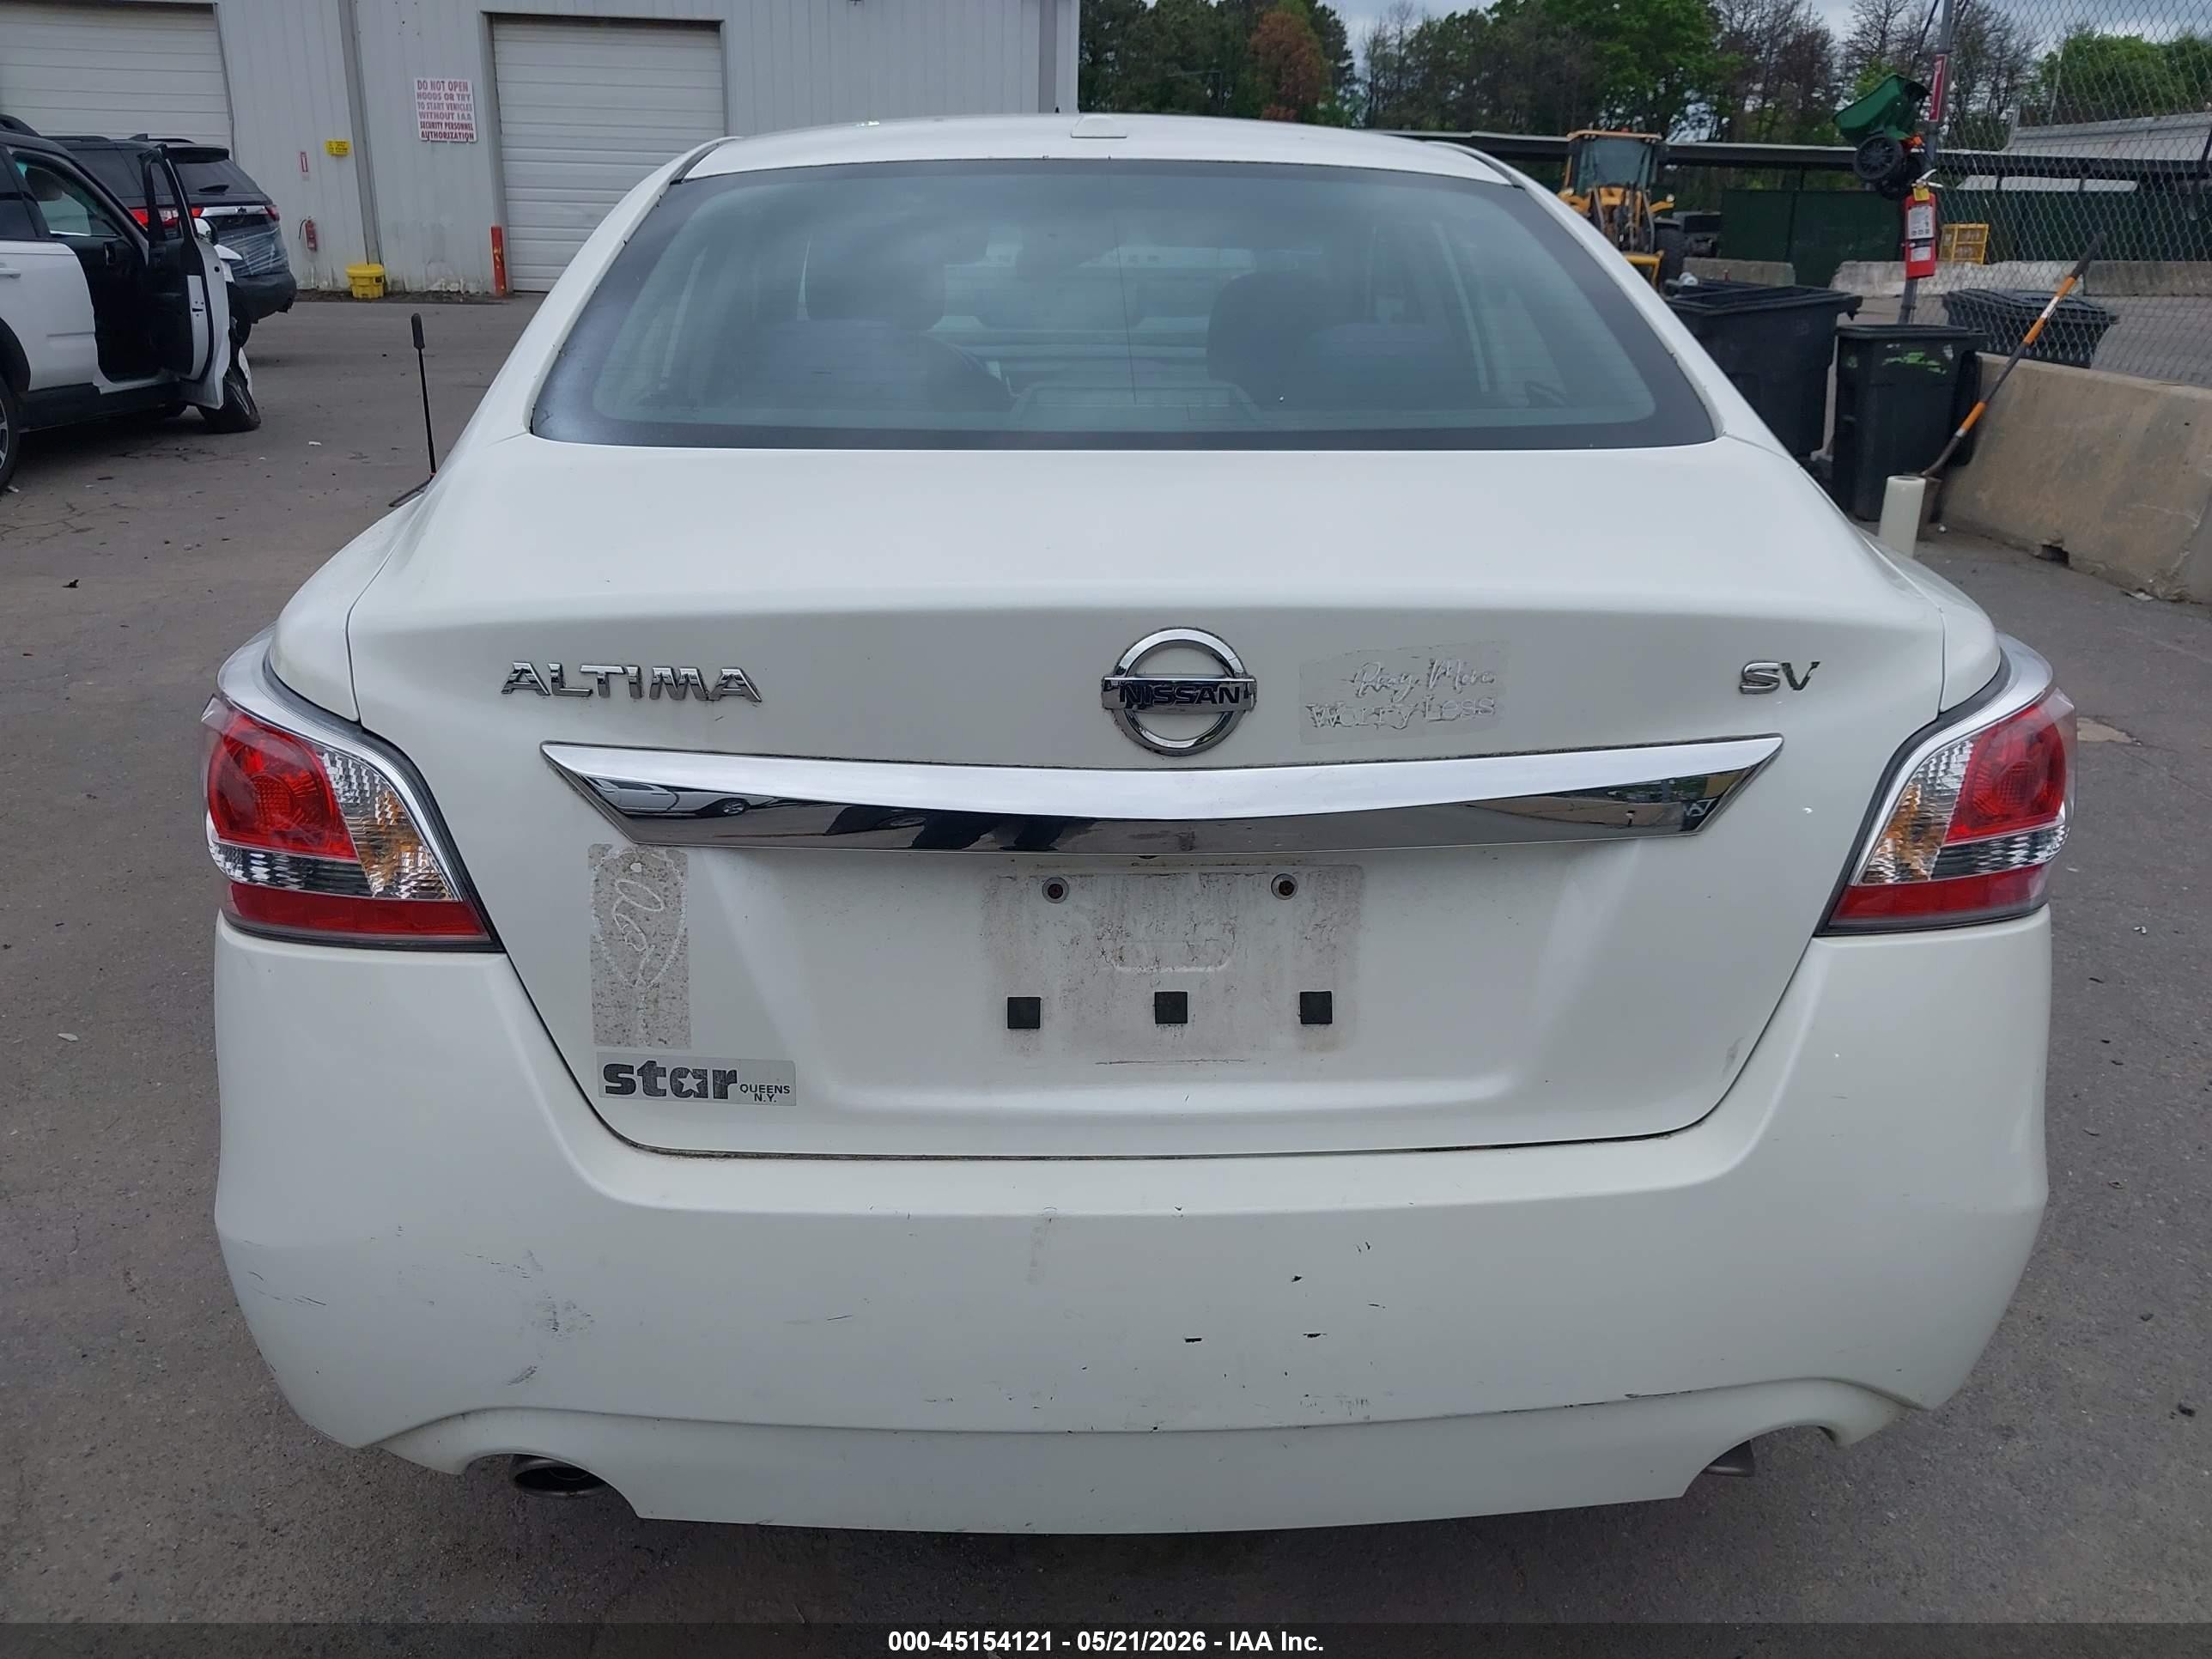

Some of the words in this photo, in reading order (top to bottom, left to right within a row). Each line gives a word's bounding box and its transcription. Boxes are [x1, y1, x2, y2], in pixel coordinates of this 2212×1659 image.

[417, 80, 428, 90] DO
[430, 80, 445, 91] NOT
[447, 81, 468, 92] OPEN
[416, 92, 442, 100] HOODS
[444, 93, 454, 101] OR
[457, 93, 471, 101] TRY
[417, 101, 425, 110] TO
[427, 102, 445, 111] START
[446, 103, 473, 112] VEHICLES
[419, 112, 454, 120] WITHOUT
[420, 121, 443, 130] SECURITY
[445, 122, 474, 131] PERSONNEL
[421, 131, 474, 140] AUTHORIZATION
[501, 660, 763, 702] ALTIMA
[1739, 659, 1821, 695] SV
[1119, 685, 1241, 705] NISSAN
[739, 1084, 791, 1095] QUEENS
[754, 1093, 777, 1103] N.Y.
